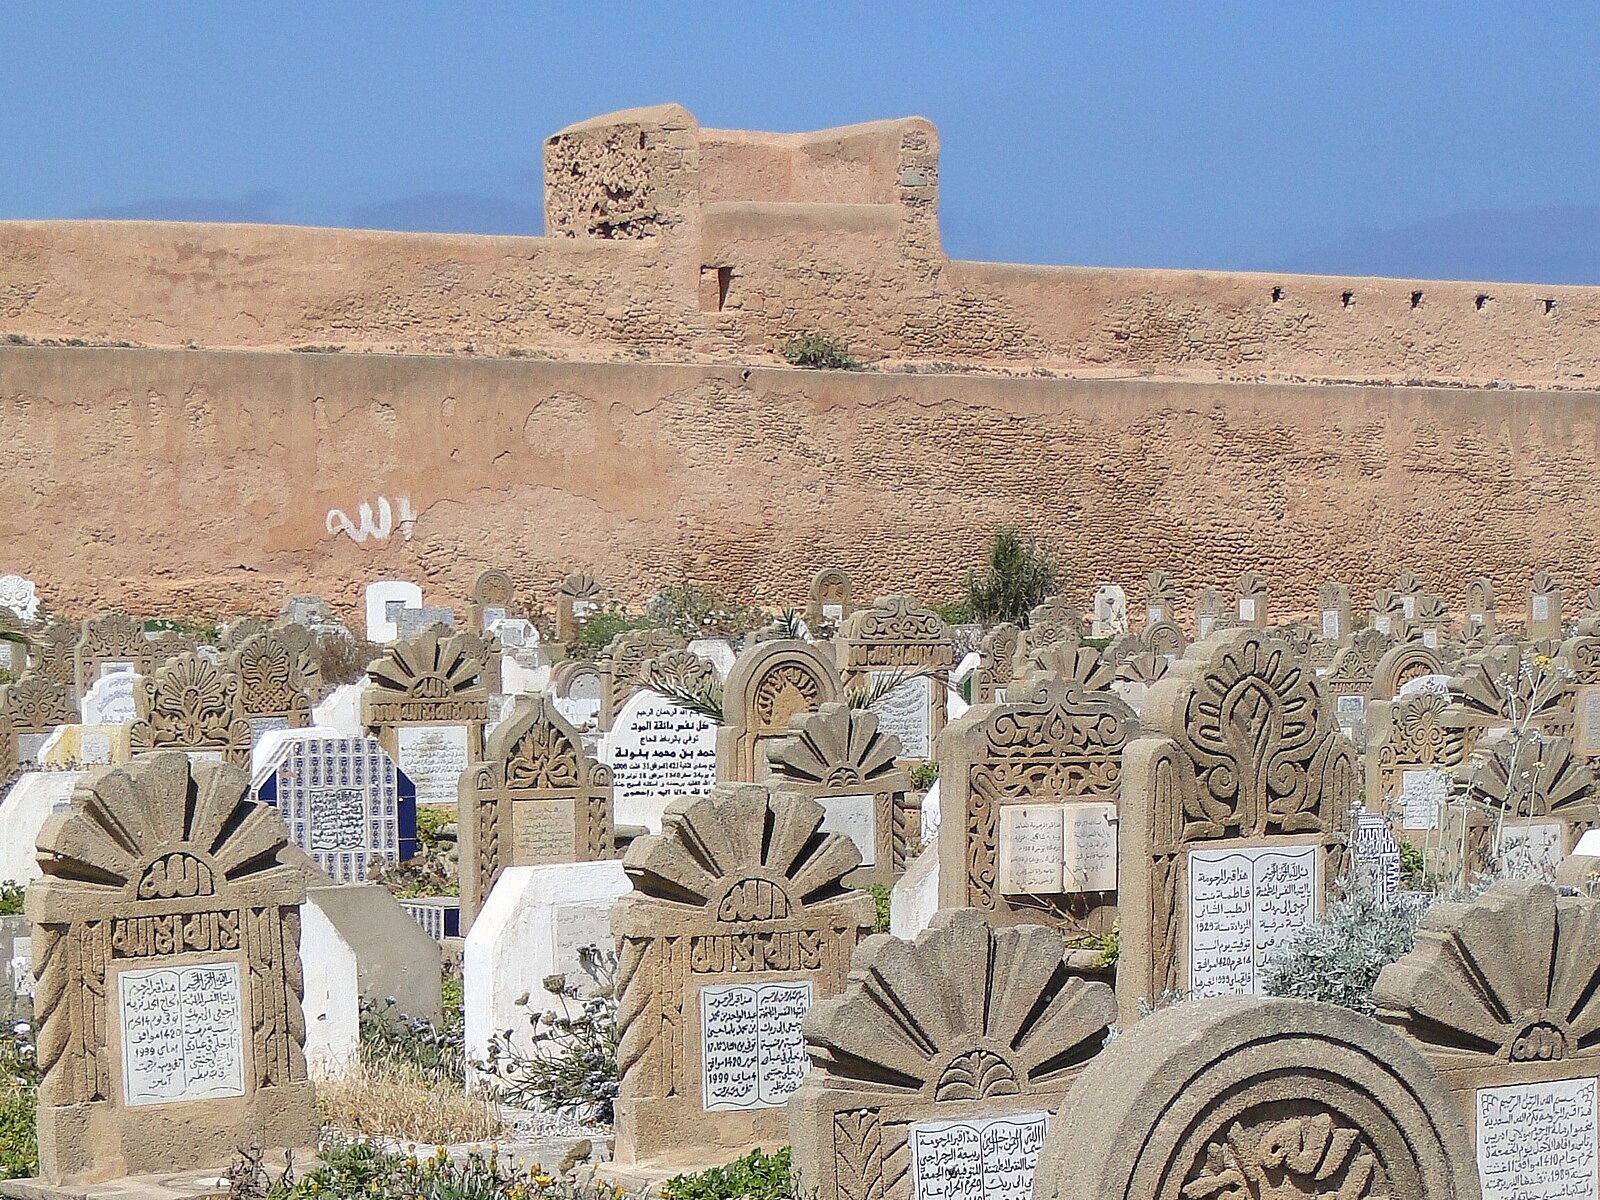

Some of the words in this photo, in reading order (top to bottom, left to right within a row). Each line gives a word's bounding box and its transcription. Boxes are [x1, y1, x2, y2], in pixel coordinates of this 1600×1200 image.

[326, 493, 417, 543] الله
[652, 749, 676, 758] محمد
[138, 852, 214, 900] الله
[718, 879, 788, 921] الله
[709, 1072, 729, 1084] 1999
[921, 1182, 943, 1200] عام
